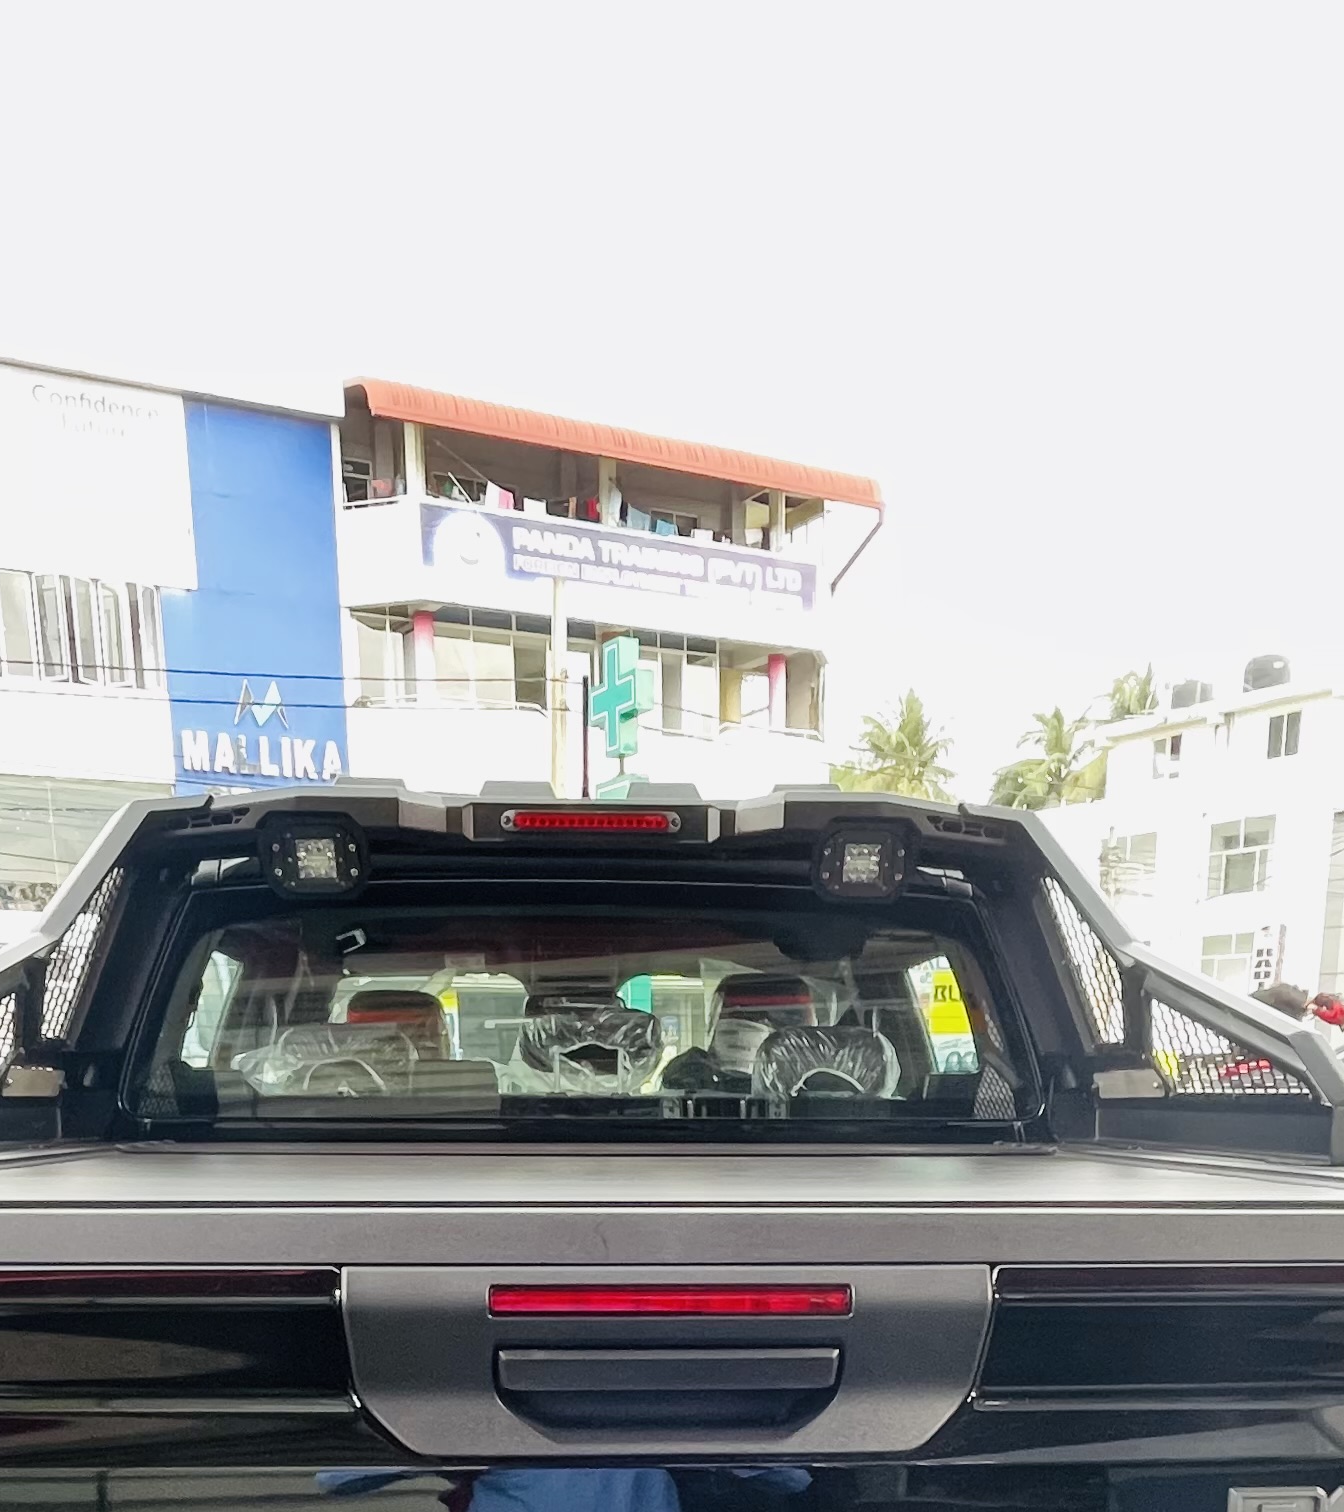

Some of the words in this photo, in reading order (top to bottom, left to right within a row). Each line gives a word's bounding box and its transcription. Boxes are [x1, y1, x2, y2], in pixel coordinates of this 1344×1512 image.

[512, 526, 596, 561] PANDA
[598, 539, 705, 577] TRAINING
[765, 566, 803, 592] LTD
[181, 729, 343, 780] MALLIKA
